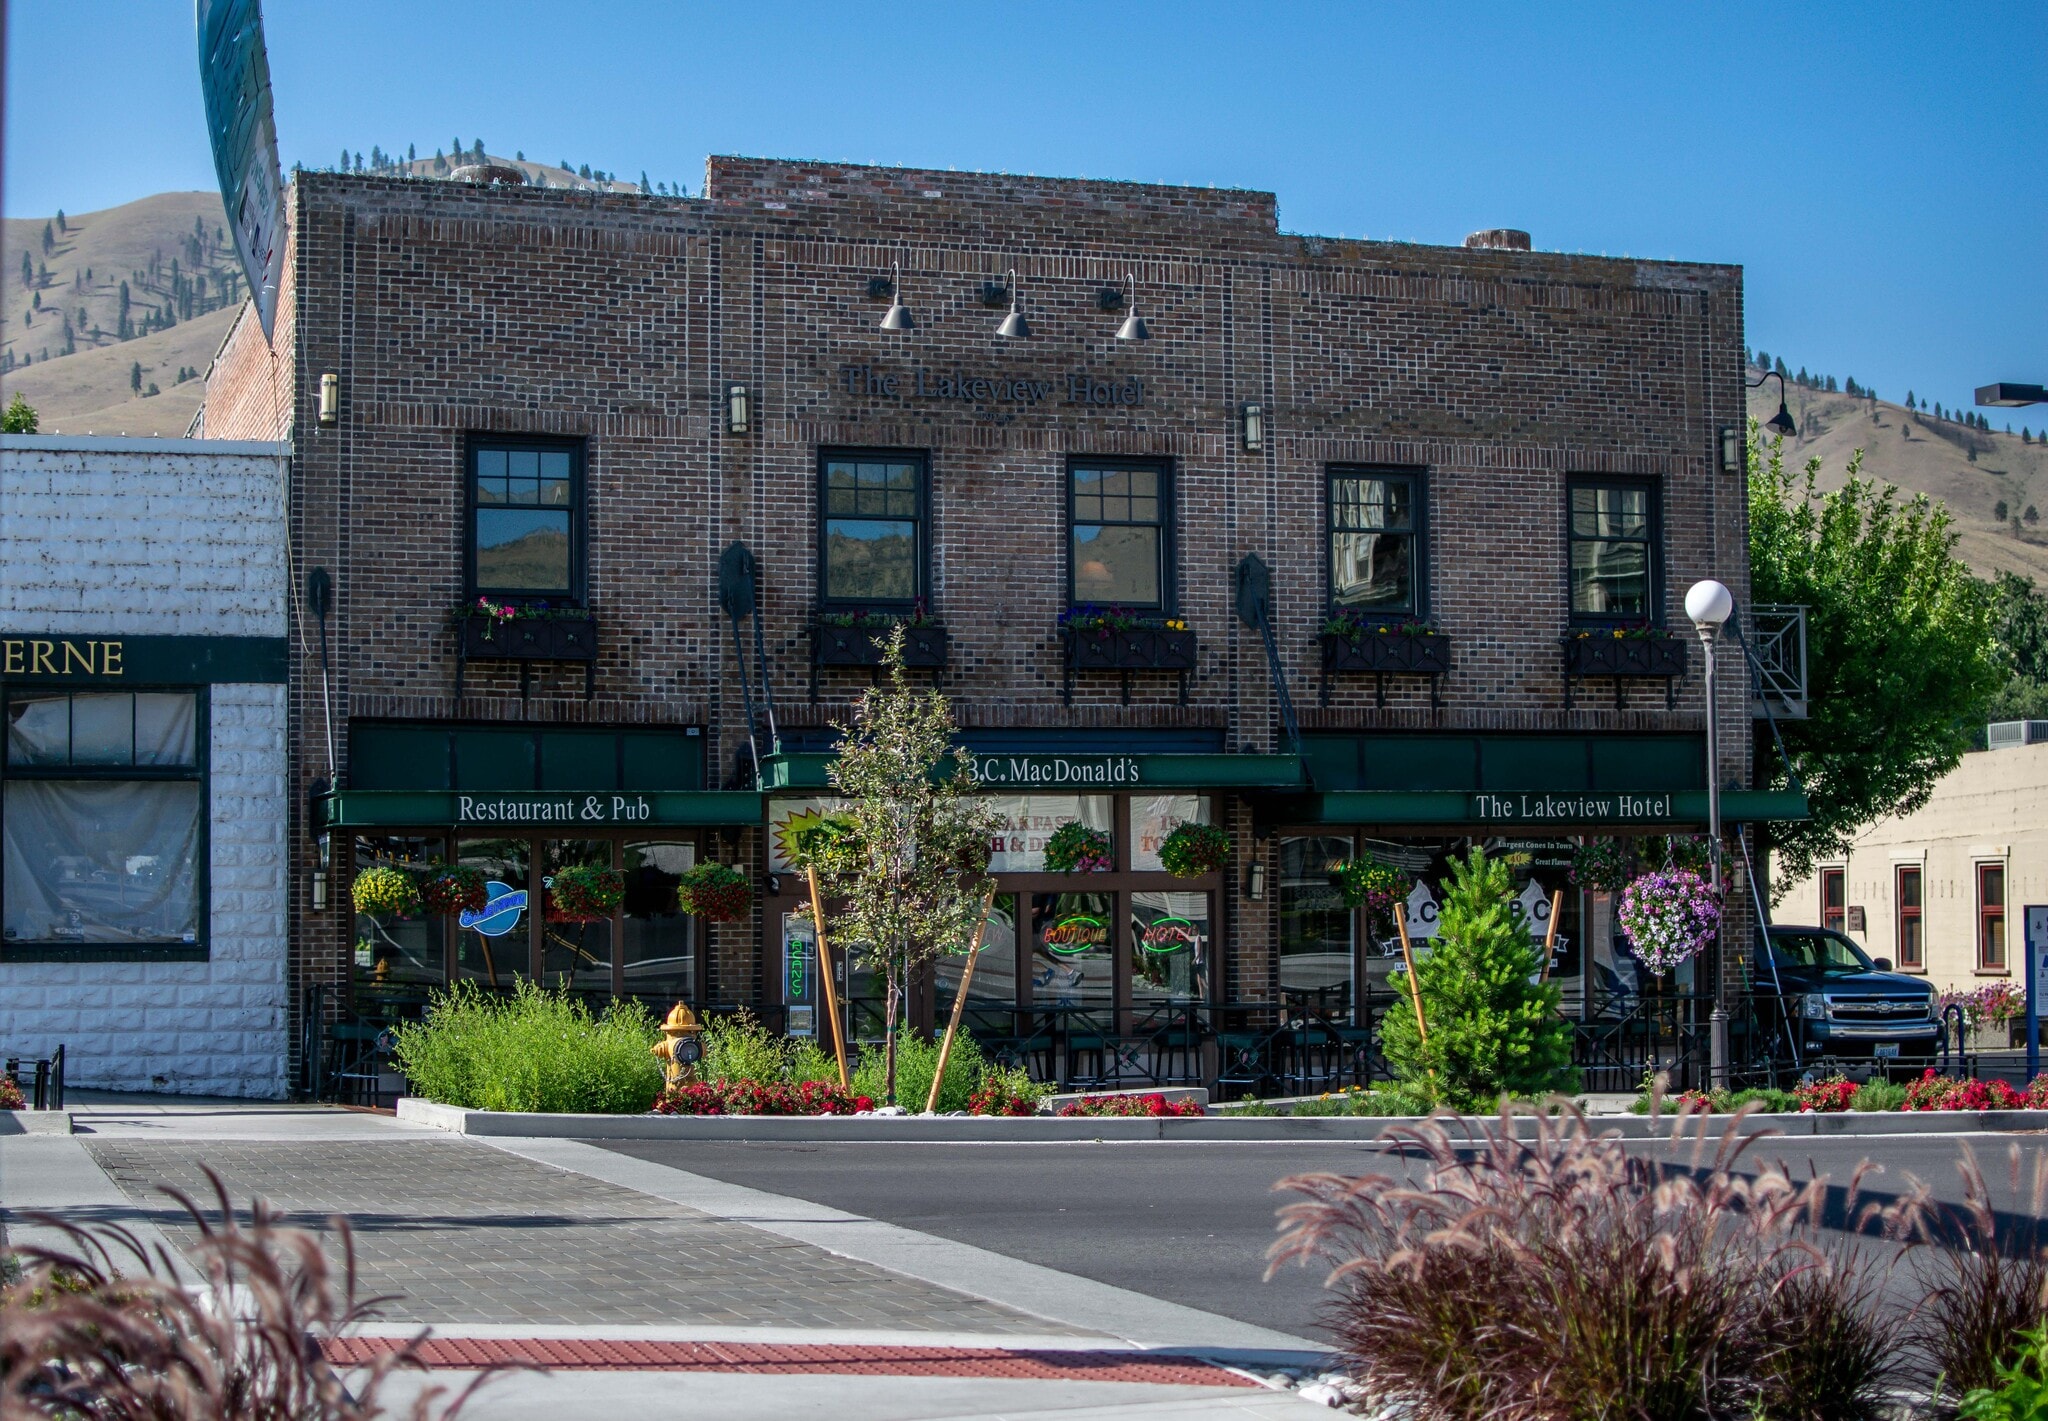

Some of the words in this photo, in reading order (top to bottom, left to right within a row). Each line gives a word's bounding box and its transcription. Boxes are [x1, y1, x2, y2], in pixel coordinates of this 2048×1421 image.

[840, 366, 898, 396] The
[916, 367, 1051, 401] Lakeview
[1067, 374, 1145, 406] Hotel
[2, 639, 124, 675] ERNE
[1010, 757, 1139, 782] MacDonald's
[459, 795, 574, 821] Restaurant
[580, 795, 605, 820] &
[611, 796, 650, 821] Pub
[1475, 794, 1513, 818] The
[1521, 794, 1611, 818] Lakeview
[1618, 794, 1671, 817] Hotel
[1498, 840, 1525, 850] Largest
[1526, 841, 1546, 849] Cones
[1547, 841, 1555, 849] In
[1555, 842, 1573, 850] Town
[1510, 854, 1521, 863] 40
[1535, 858, 1551, 866] Great
[1043, 926, 1108, 944] BOUTIQUE
[1143, 926, 1193, 943] HOTEL
